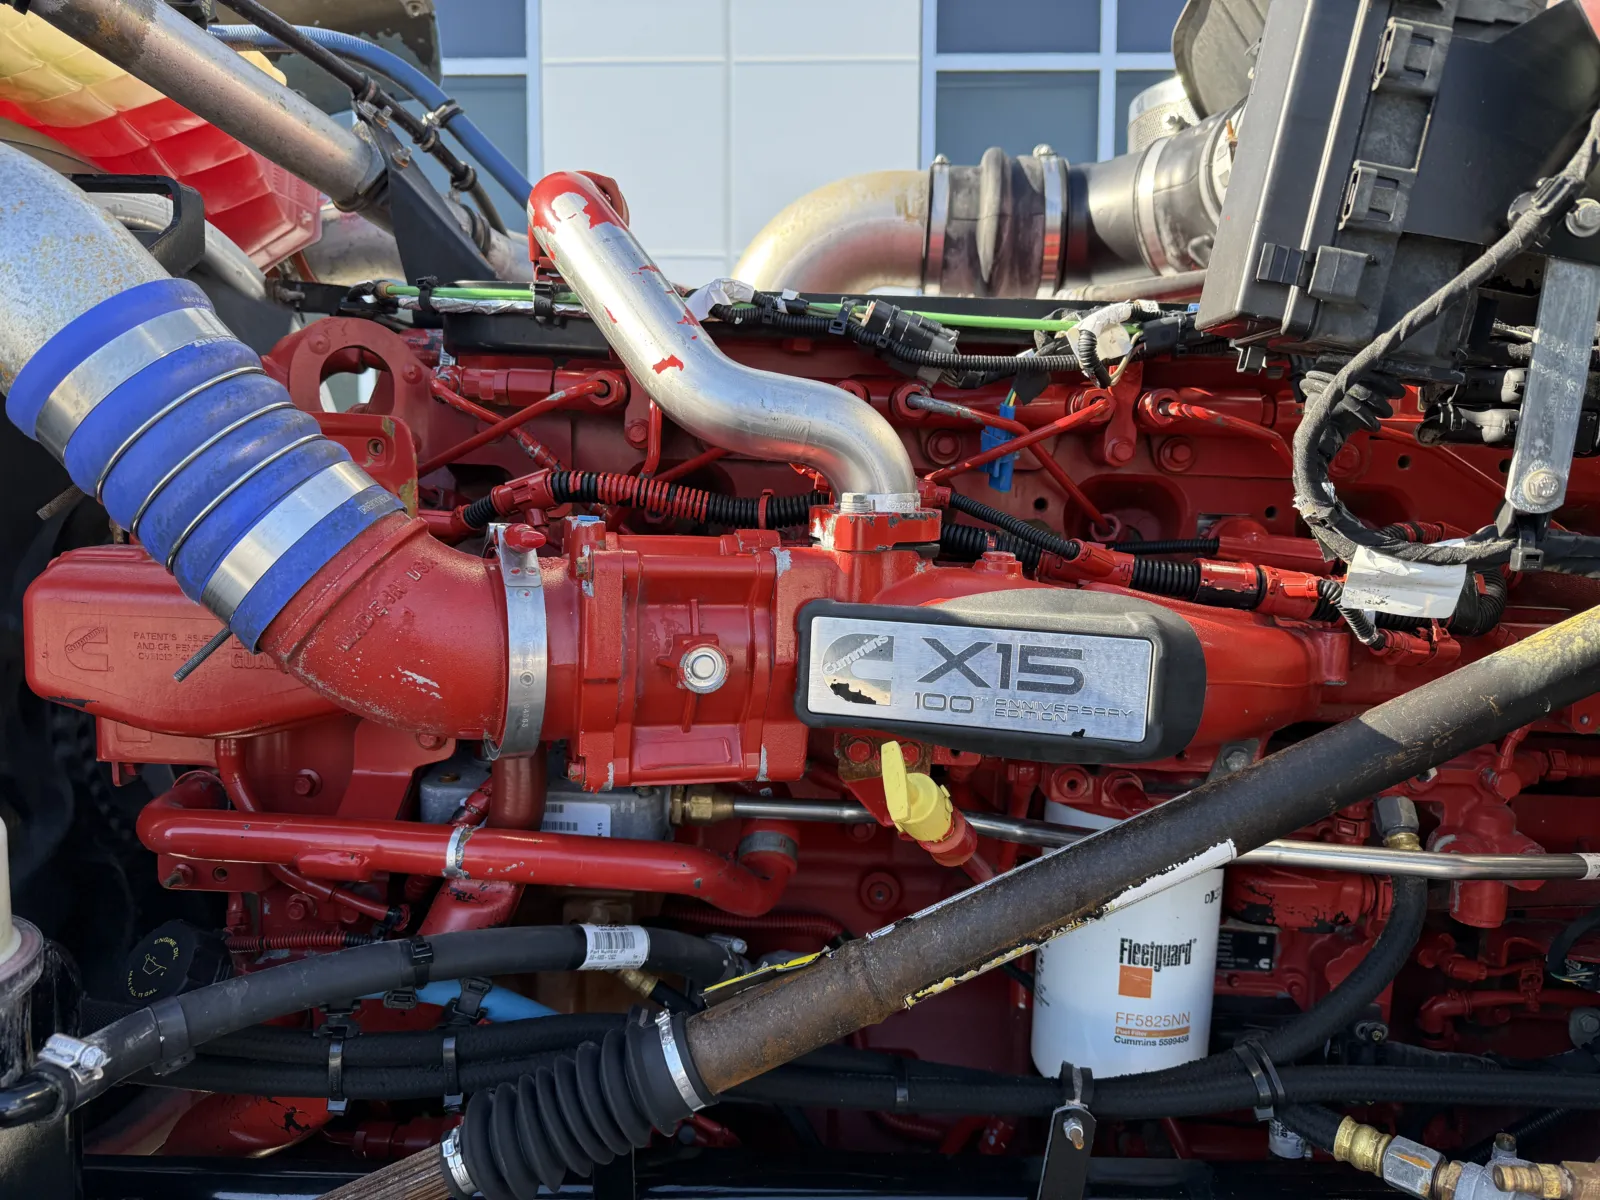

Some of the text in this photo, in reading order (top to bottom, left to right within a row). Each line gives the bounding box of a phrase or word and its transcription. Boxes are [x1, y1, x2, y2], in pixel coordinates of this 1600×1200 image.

[822, 635, 889, 676] Cummins
[916, 637, 1085, 695] X15
[994, 698, 1133, 718] ANNIVERSARY
[994, 708, 1068, 722] EDITION
[1119, 937, 1193, 972] Fleetguard
[1115, 1011, 1191, 1028] FF5825NN
[1113, 1035, 1157, 1047] Cummins
